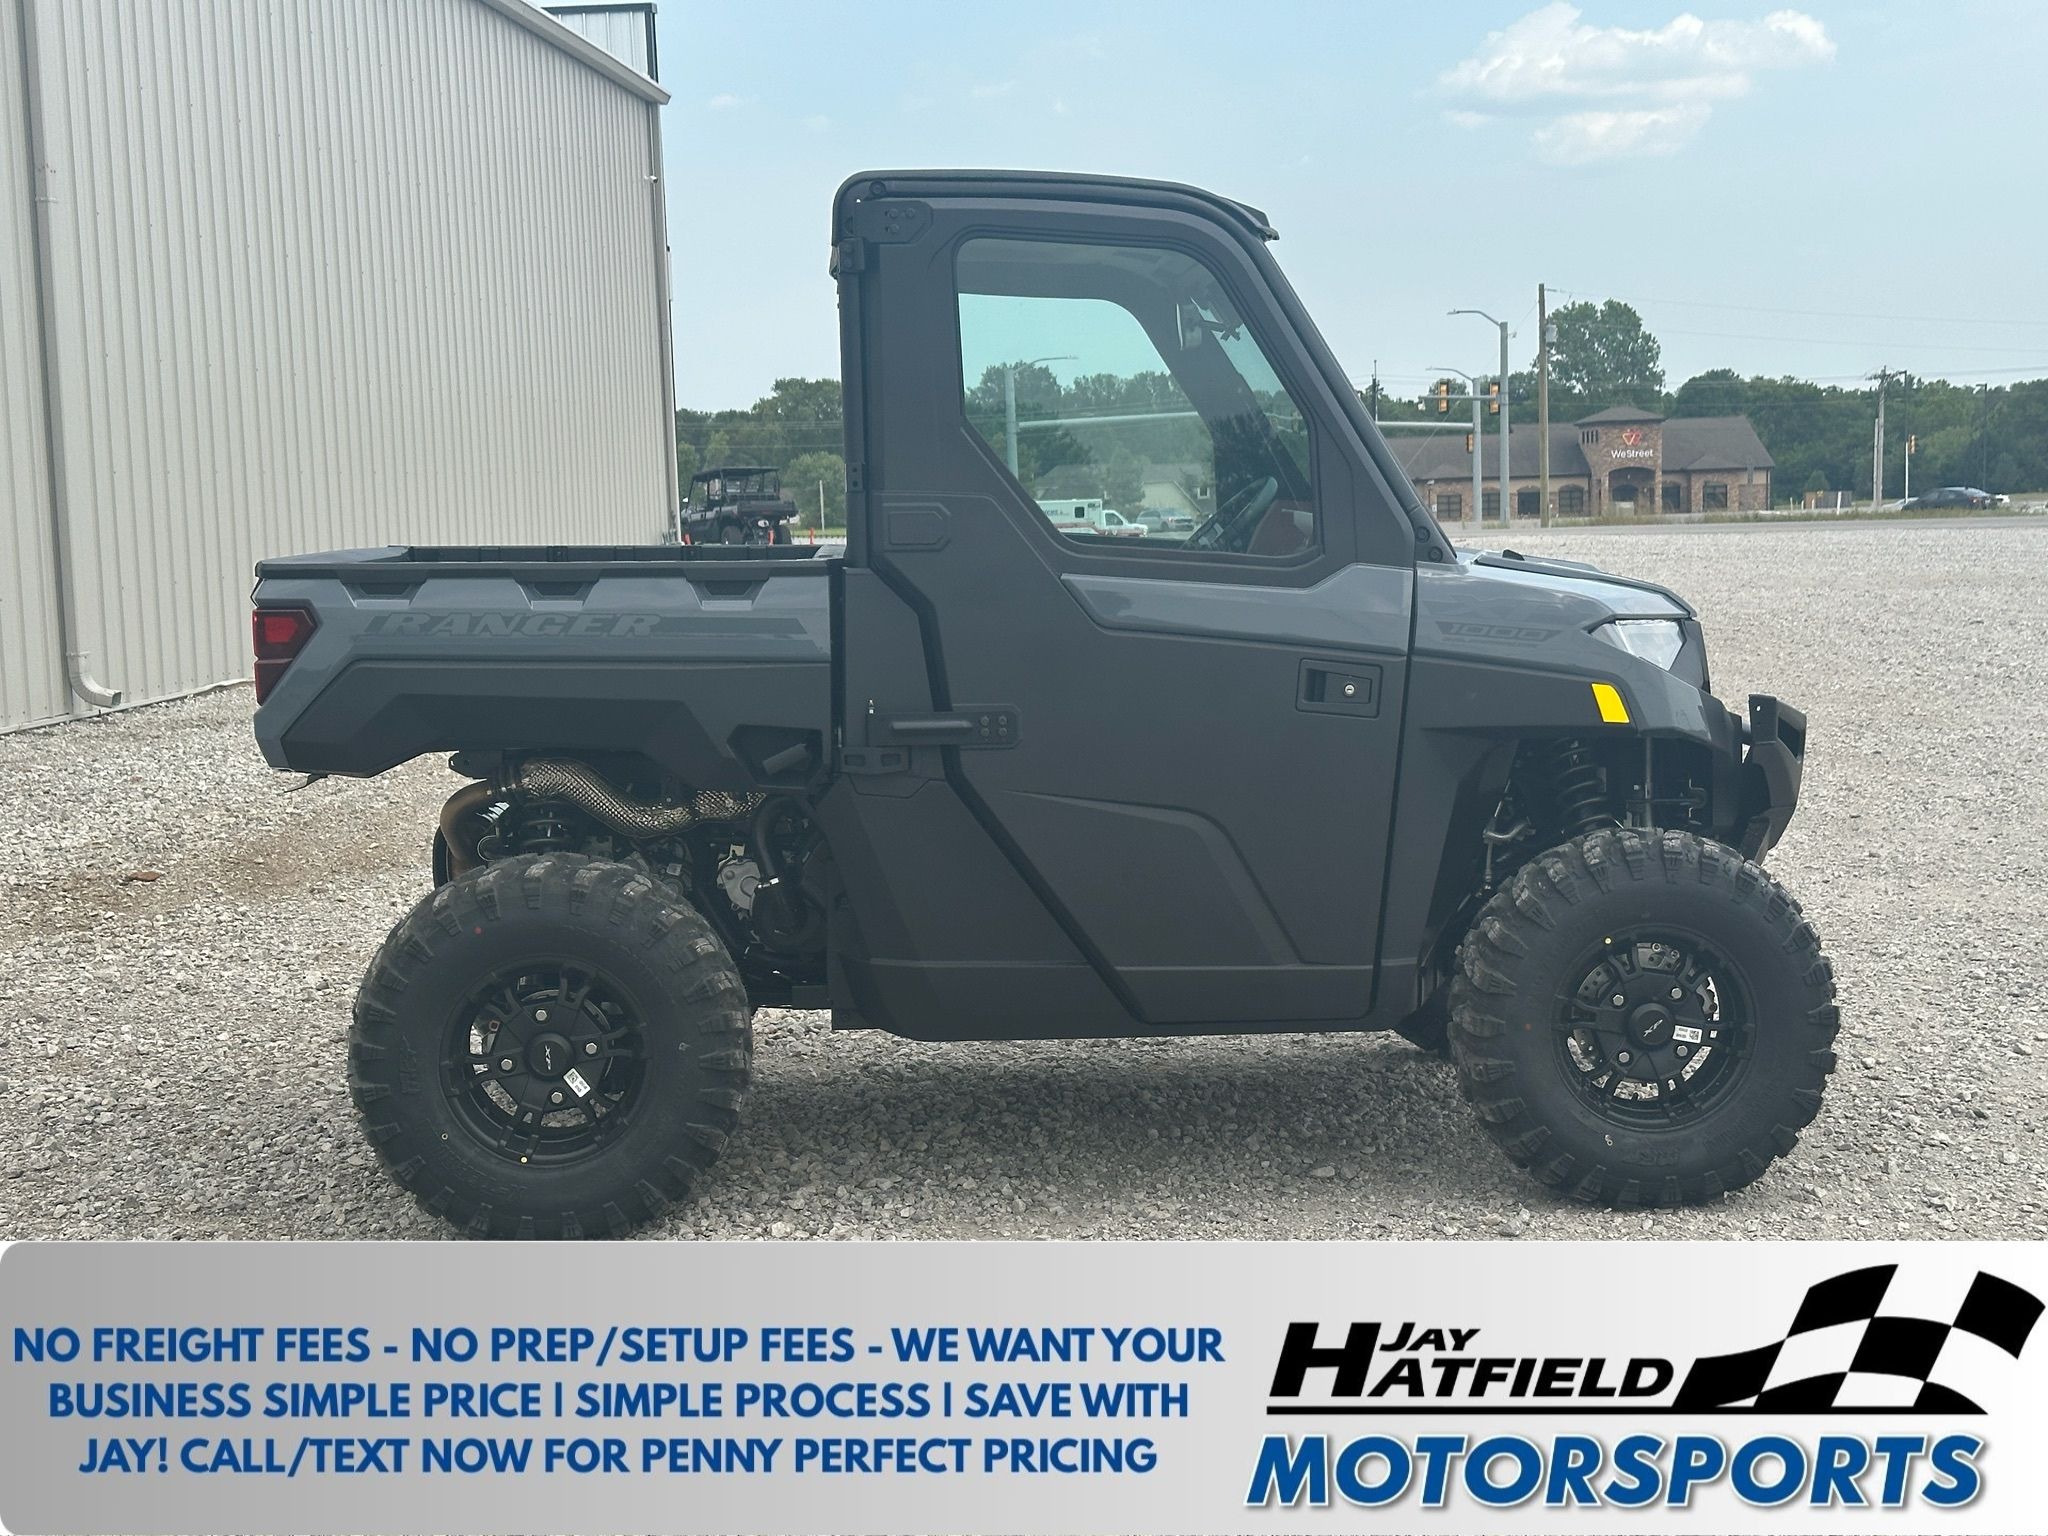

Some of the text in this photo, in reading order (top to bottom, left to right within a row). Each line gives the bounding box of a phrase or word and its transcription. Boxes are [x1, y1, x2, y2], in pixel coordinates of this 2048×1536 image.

[1610, 448, 1653, 460] WeStreet
[383, 612, 663, 637] RANGER
[1450, 623, 1548, 641] 1000
